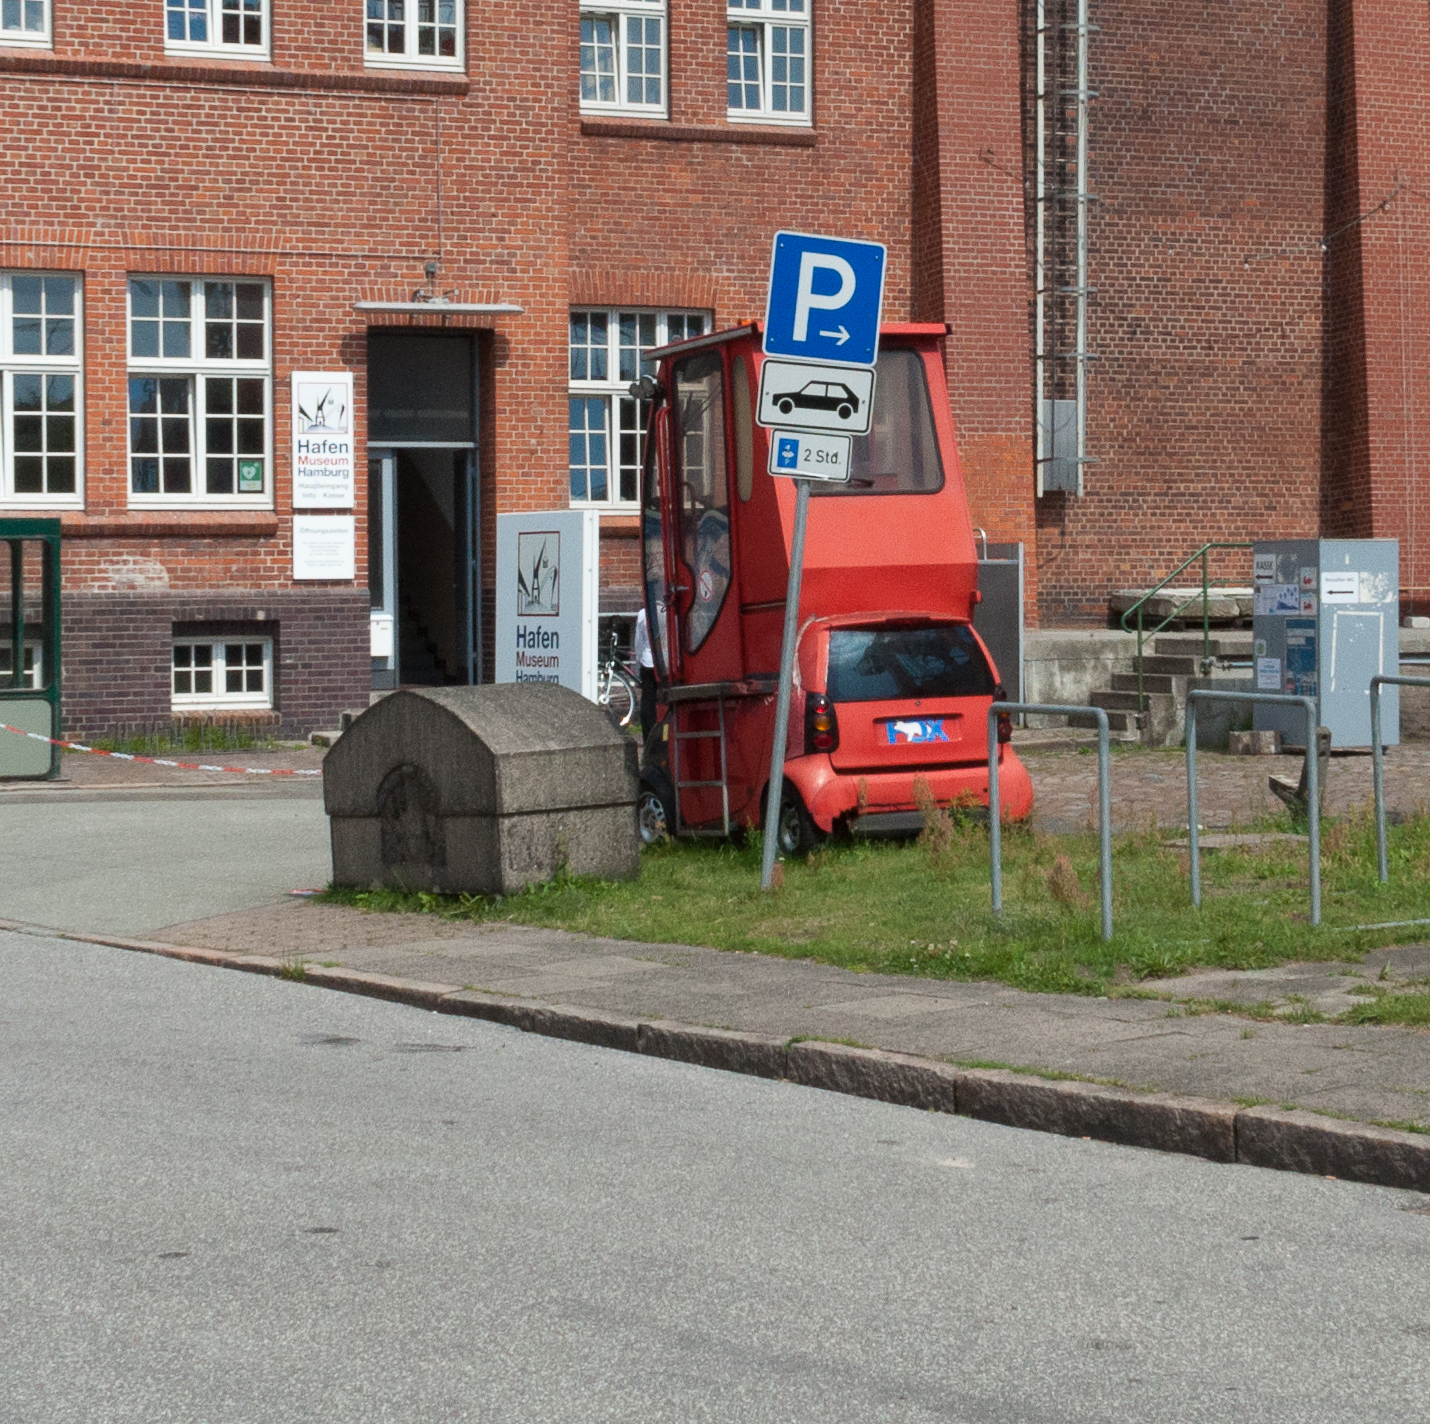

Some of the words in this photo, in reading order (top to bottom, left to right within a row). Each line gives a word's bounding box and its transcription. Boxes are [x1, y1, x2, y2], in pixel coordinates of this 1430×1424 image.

[792, 251, 856, 342] P
[297, 439, 349, 454] Hafen
[297, 455, 349, 466] Museum
[803, 448, 812, 462] 2
[815, 449, 842, 465] Std.
[297, 467, 349, 480] Hamburg
[516, 625, 559, 649] Hafen
[516, 651, 559, 668] Museum
